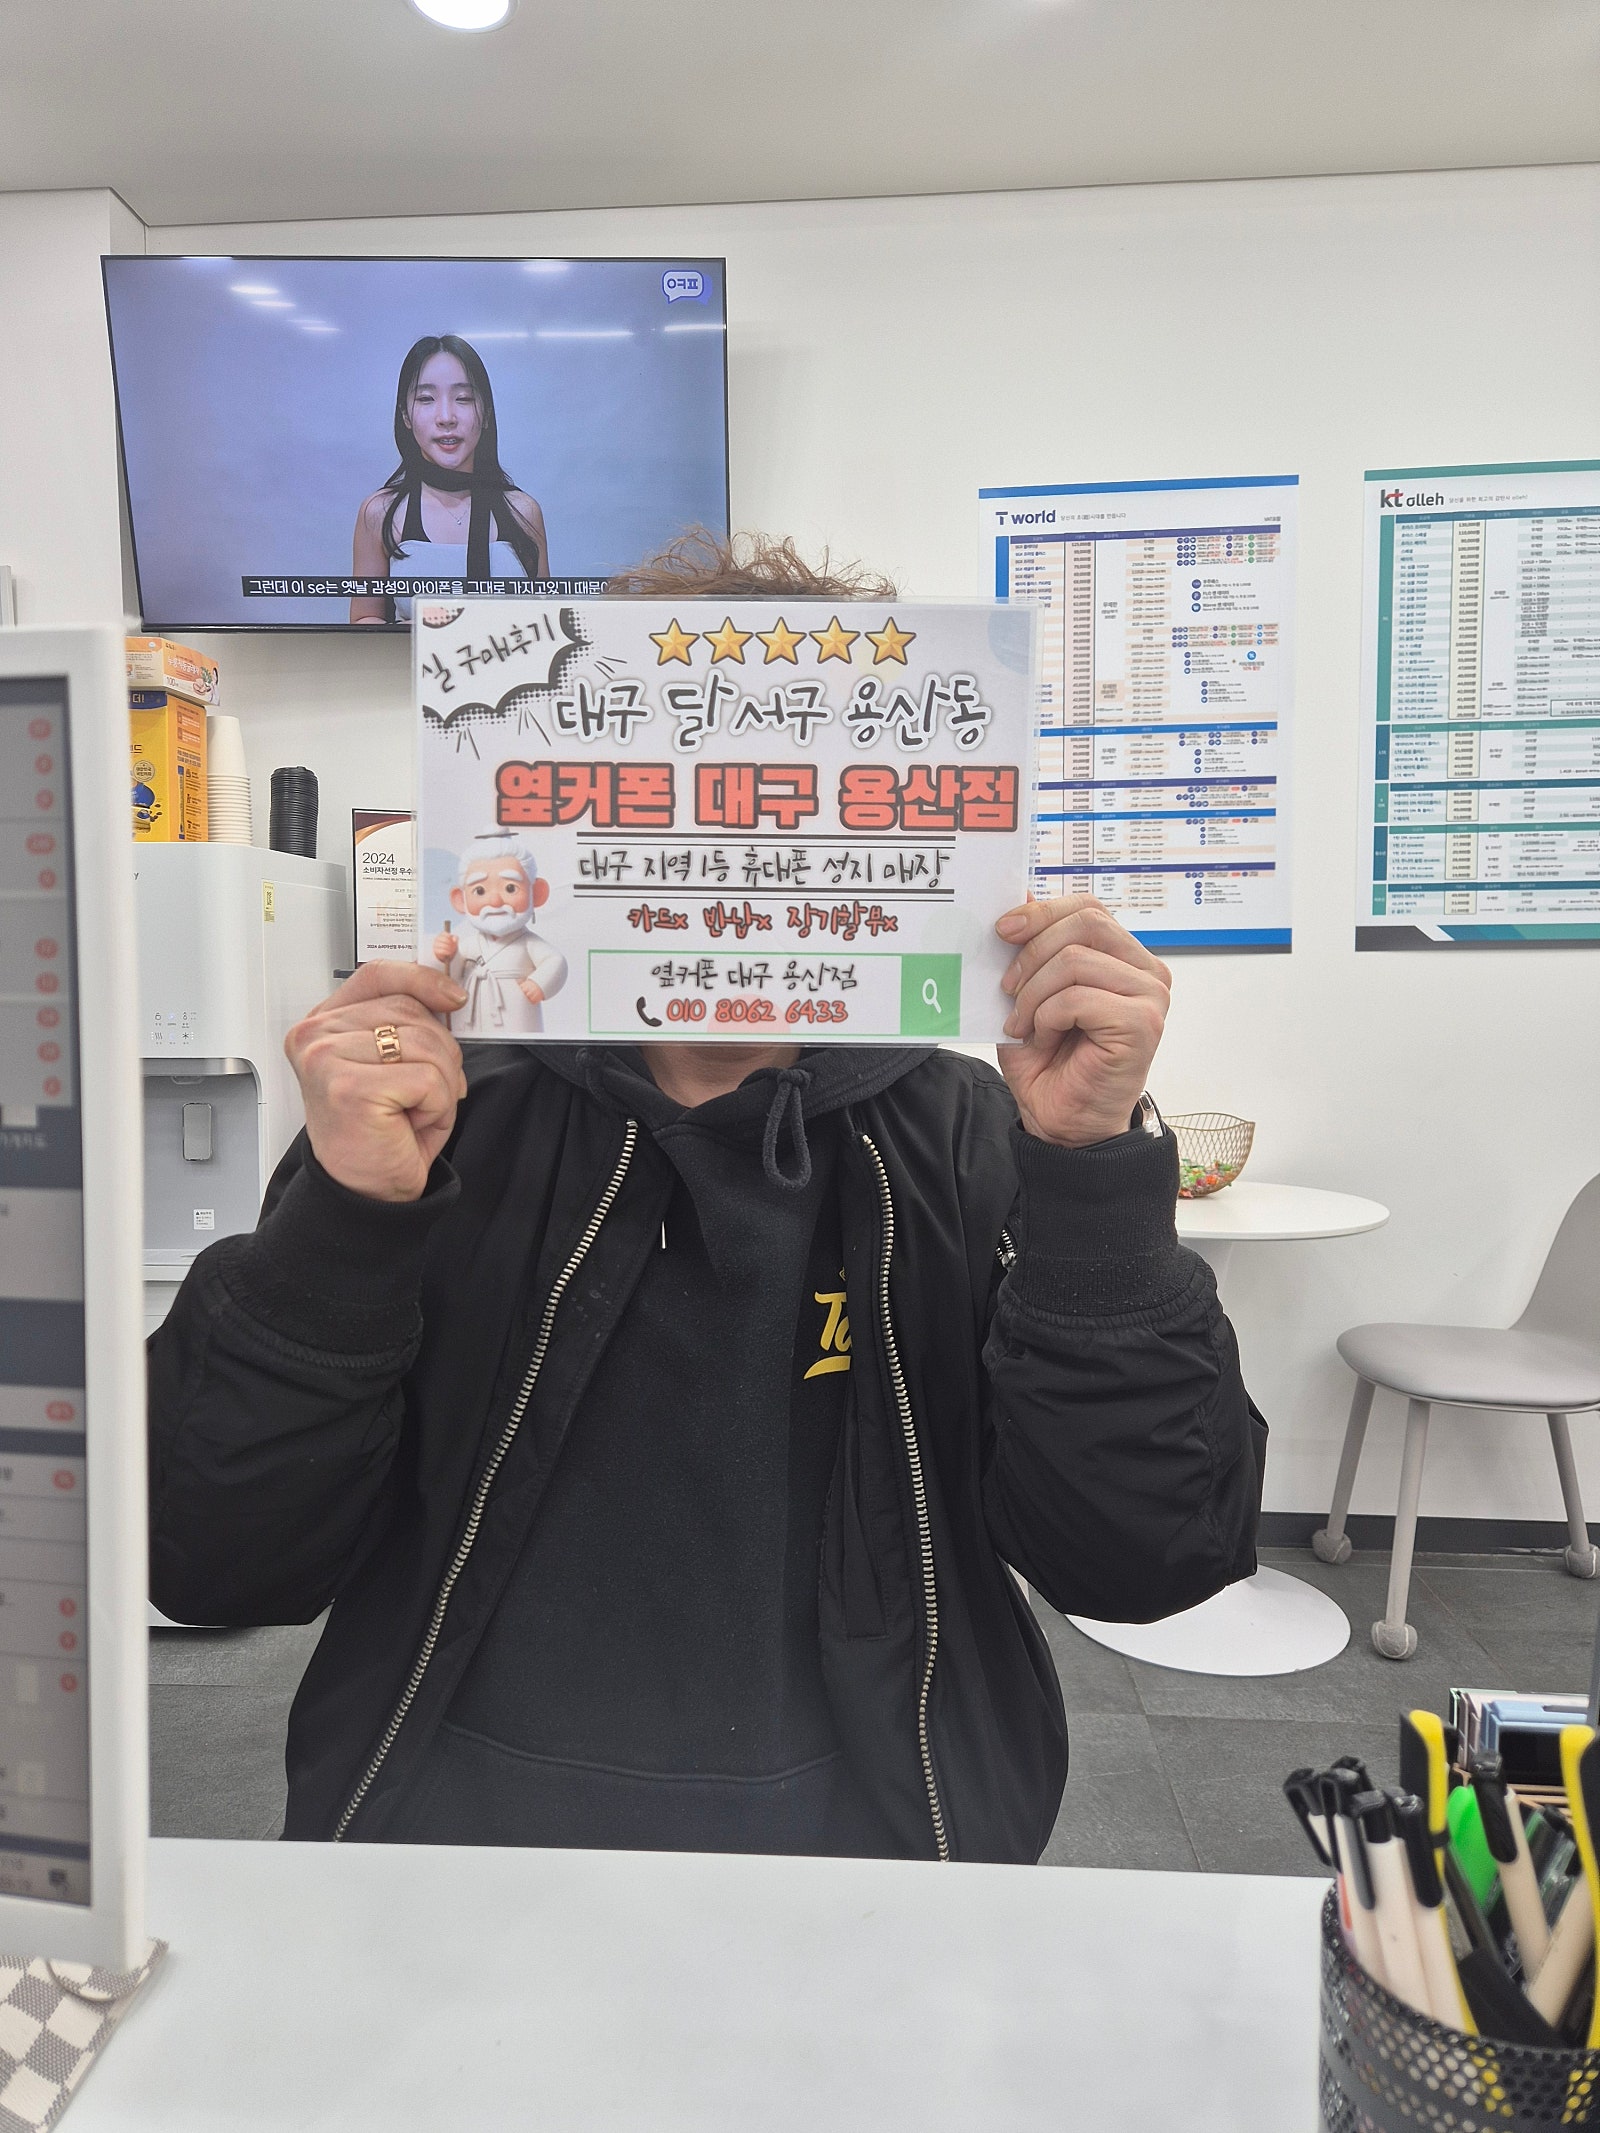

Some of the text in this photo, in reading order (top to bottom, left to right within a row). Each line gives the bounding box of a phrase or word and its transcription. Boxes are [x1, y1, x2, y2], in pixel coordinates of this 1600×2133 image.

[1380, 489, 1444, 508] kt olleh
[995, 510, 1056, 525] T world
[249, 580, 288, 594] 그런데
[291, 580, 304, 594] 이
[307, 580, 339, 594] se는
[341, 580, 368, 594] 옛날
[371, 580, 410, 594] 감성의
[412, 580, 463, 595] 아이폰을
[467, 581, 506, 595] 그대로
[509, 581, 571, 595] 가지고있기
[423, 613, 556, 693] 실 구매후기
[556, 674, 987, 746] 대구 달서구 용산동
[496, 761, 675, 829] 옆커폰
[695, 763, 819, 829] 대구
[838, 765, 1019, 832] 용산점
[362, 852, 395, 865] 2024
[362, 867, 398, 876] 소비자선정
[579, 849, 632, 881] 대구
[742, 846, 811, 888] 휴대폰
[823, 851, 873, 883] 성지
[883, 849, 951, 888] 매장
[651, 959, 858, 991] 옆커폰 대구 용산점
[666, 998, 849, 1024] 010 8062 6433
